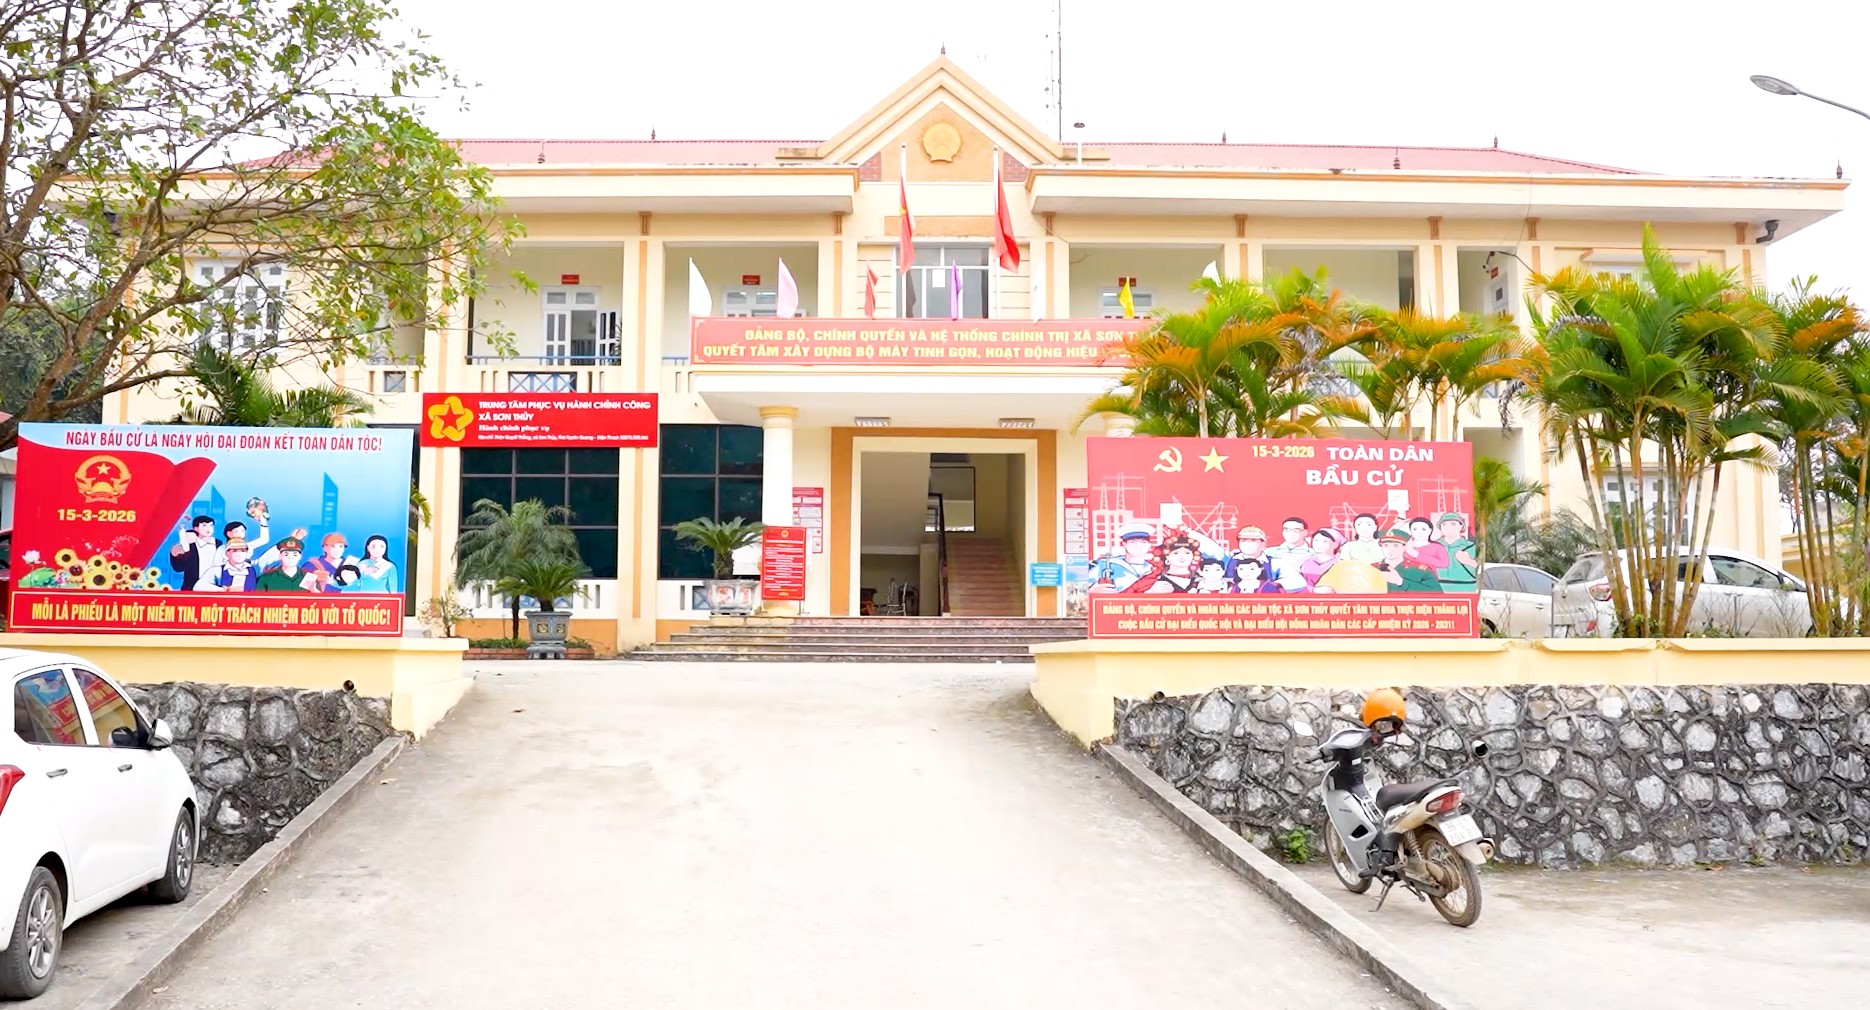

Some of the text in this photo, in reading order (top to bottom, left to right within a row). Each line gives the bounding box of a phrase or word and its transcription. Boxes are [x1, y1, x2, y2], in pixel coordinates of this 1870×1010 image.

[745, 326, 783, 341] ĐẢNG
[814, 328, 856, 341] CHÍNH
[860, 328, 905, 342] QUYỀN
[909, 329, 927, 341] VÀ
[931, 328, 948, 343] HỆ
[953, 328, 998, 342] THỐNG
[1002, 328, 1044, 342] CHÍNH
[1048, 331, 1069, 344] TRỊ
[1074, 329, 1092, 341] XÃ
[703, 342, 746, 358] QUYẾT
[750, 344, 779, 357] TÂM
[784, 344, 810, 357] XÂY
[856, 345, 874, 359] BỘ
[878, 345, 909, 357] MÁY
[913, 347, 944, 357] TINH
[985, 347, 1021, 360] HOẠT
[1024, 346, 1062, 360] ĐỘNG
[1066, 345, 1097, 359] HIỆU
[479, 399, 651, 411] TRUNG TÂM PHỤC VỤ HÀNH CHÍNH CÔNG
[478, 411, 534, 421] XÃ SƠN THỦY
[66, 427, 382, 454] NGÀY BẦU CỬ LÀ NGÀY HỘI ĐẠI ĐOÀN KẾT TOÀN DÂN TỘC!
[1252, 445, 1434, 461] 15-3-2026 TOÀN DÂN
[1306, 464, 1404, 486] BẦU CỬ
[58, 509, 136, 522] 15-3-2026
[32, 597, 390, 628] MỖI LÁ PHIẾU LÀ MỘT NIỀM TIN, MỘT TRÁCH NHIỆM ĐỐI VỚI TỔ QUỐC!
